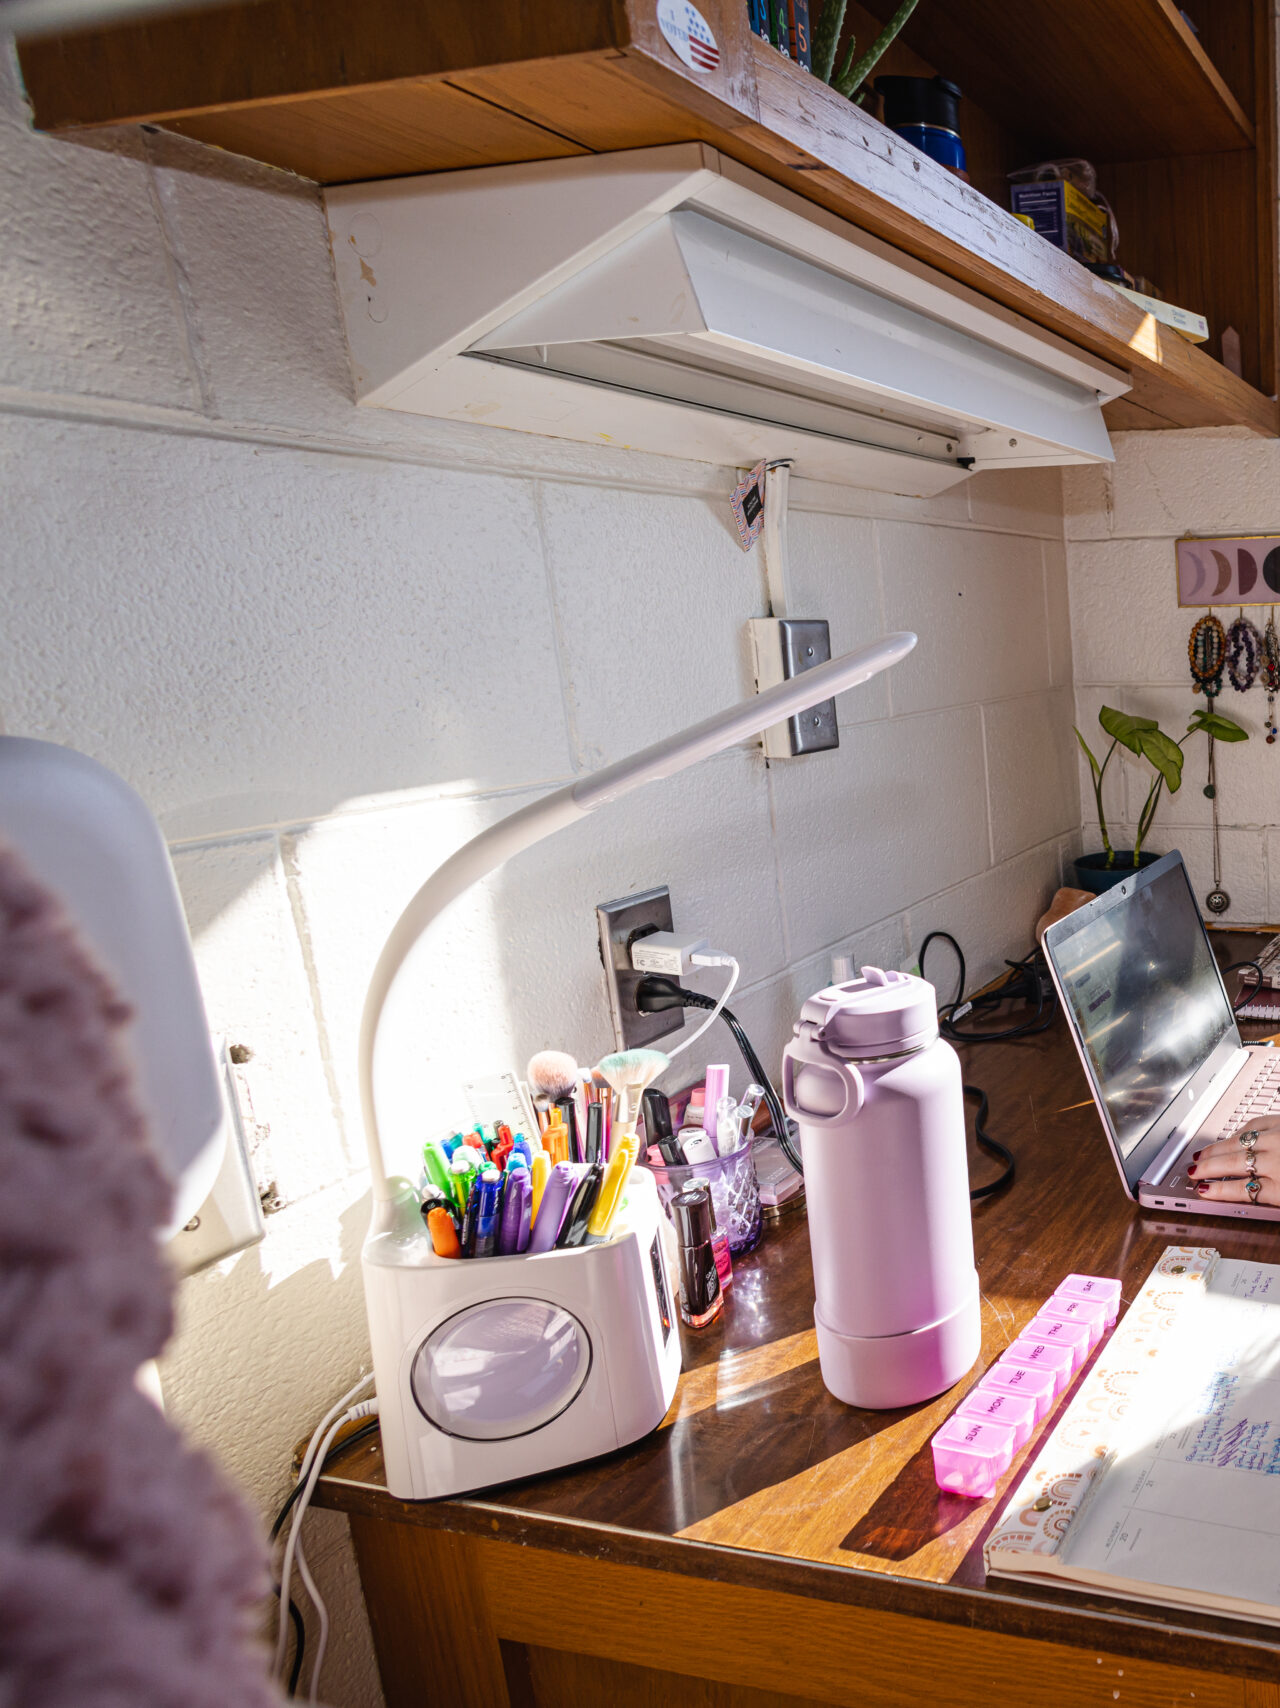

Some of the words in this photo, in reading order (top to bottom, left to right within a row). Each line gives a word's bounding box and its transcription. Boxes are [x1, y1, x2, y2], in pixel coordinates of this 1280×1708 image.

[660, 18, 689, 42] VOTED
[798, 22, 808, 53] 5
[1083, 1280, 1096, 1293] SAT
[1067, 1301, 1080, 1314] FRI
[1048, 1323, 1063, 1337] THU
[1029, 1345, 1046, 1360] WED
[1009, 1369, 1026, 1385] TUE
[987, 1396, 1006, 1414] MON
[965, 1424, 983, 1442] SUN
[1105, 1521, 1121, 1548] MONDAY
[1119, 1532, 1129, 1542] 20
